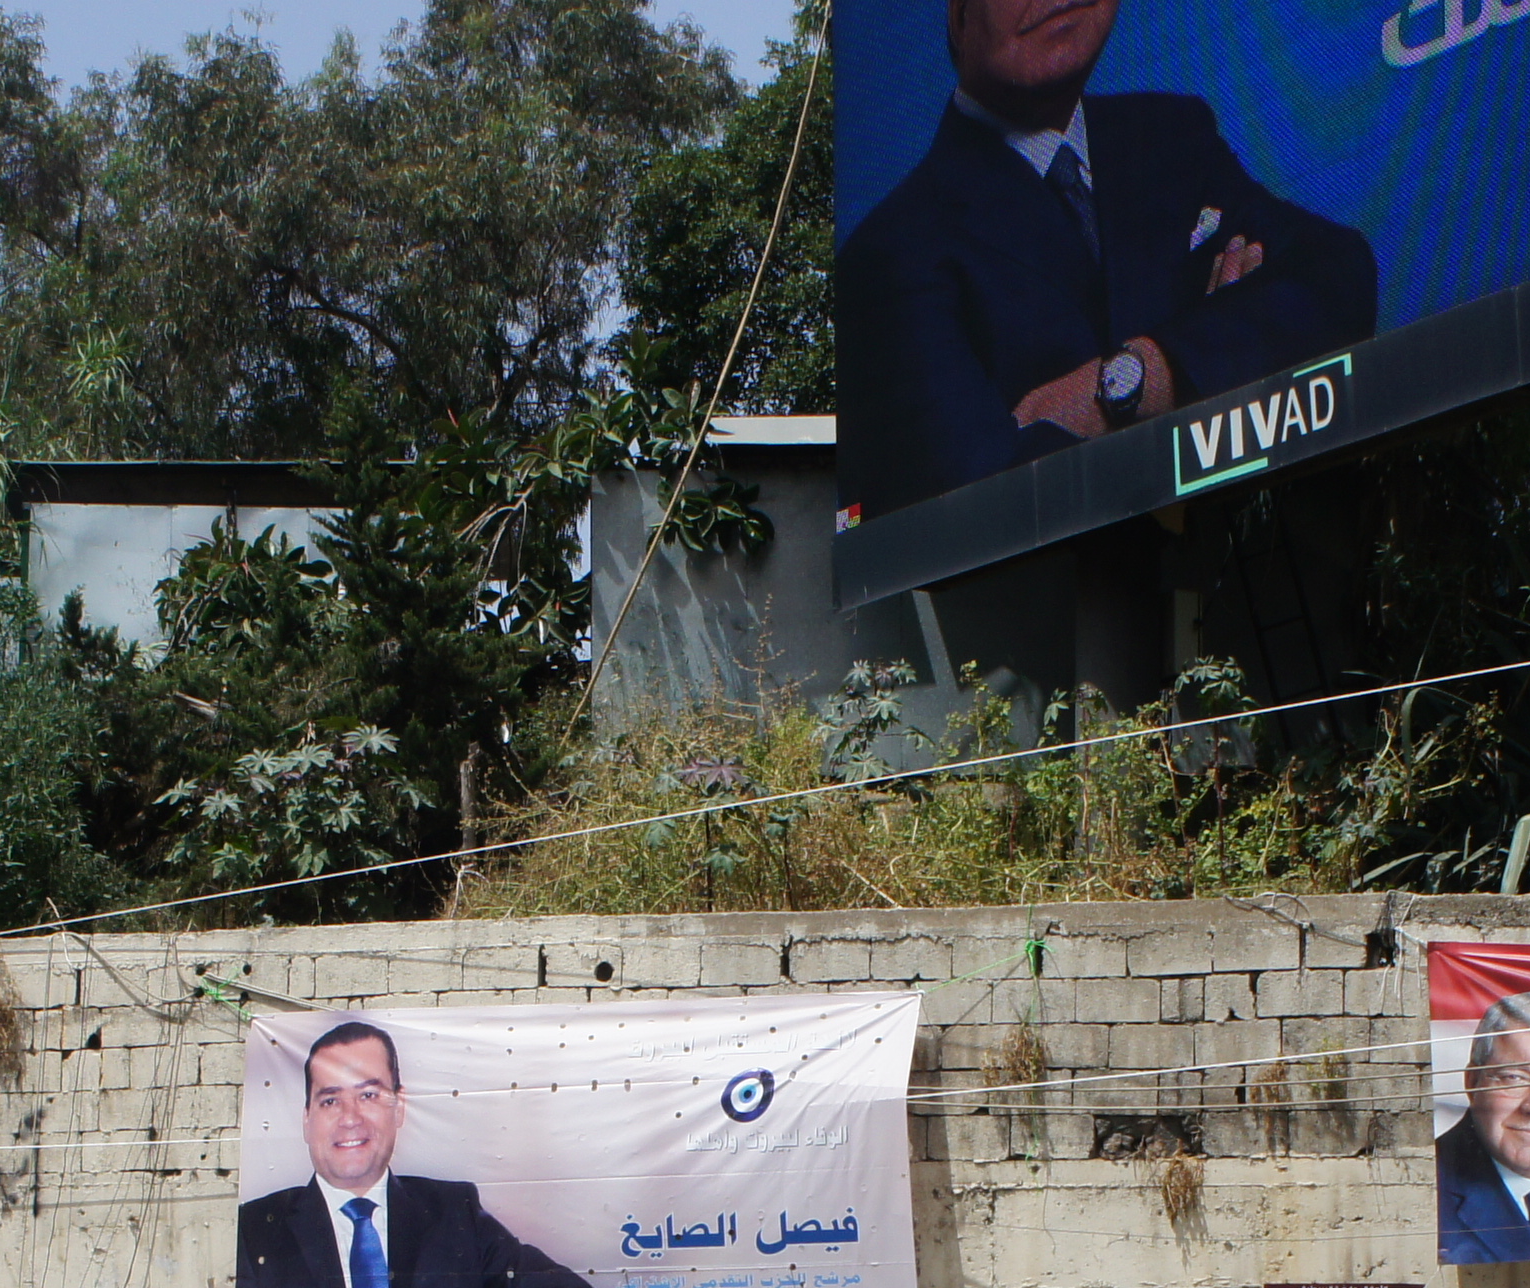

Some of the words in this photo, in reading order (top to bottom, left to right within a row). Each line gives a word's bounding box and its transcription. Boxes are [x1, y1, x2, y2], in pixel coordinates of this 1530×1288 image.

[1189, 375, 1335, 470] VIVAD
[619, 1211, 738, 1259] الصايغ
[755, 1206, 860, 1256] فيصل
[813, 1271, 861, 1288] مرشح
